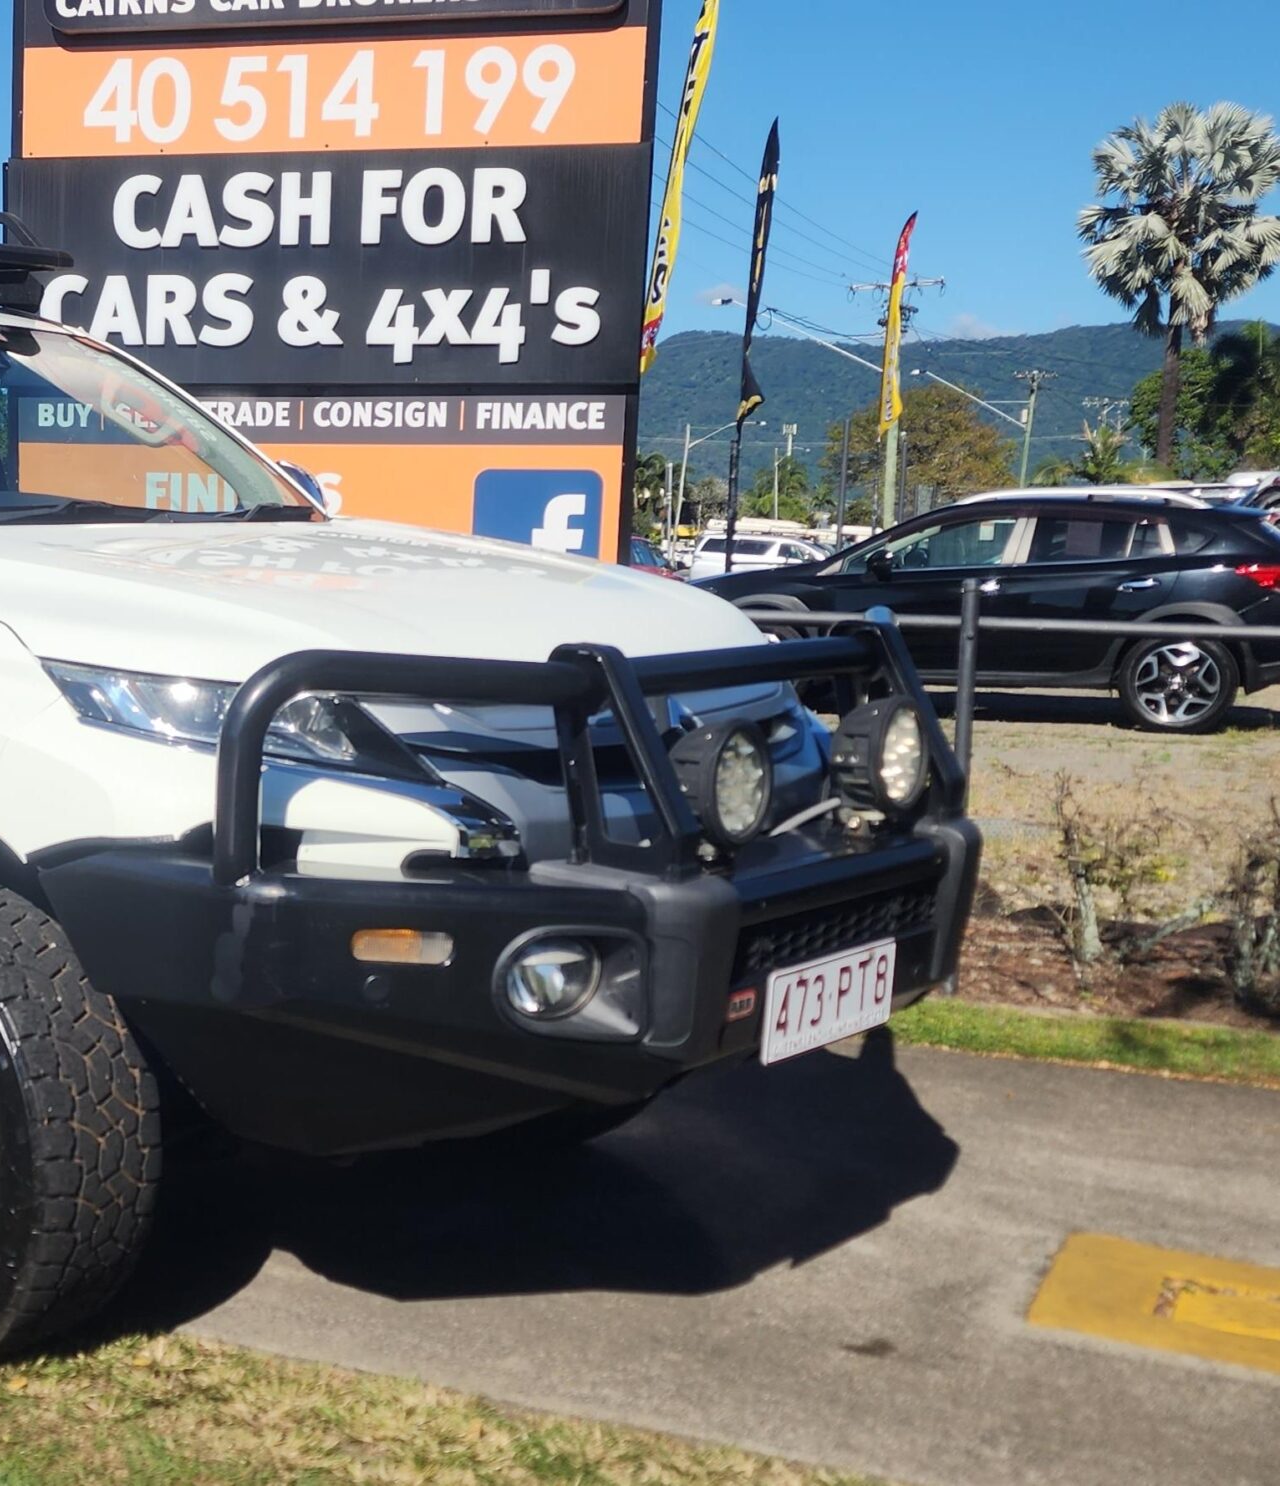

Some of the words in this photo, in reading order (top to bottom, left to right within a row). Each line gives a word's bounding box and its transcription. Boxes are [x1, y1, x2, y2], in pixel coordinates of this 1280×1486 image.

[82, 57, 192, 144] 40
[213, 50, 379, 141] 514
[413, 44, 576, 135] 199
[112, 171, 332, 249] CASH
[360, 167, 527, 246] FOR
[41, 272, 254, 347] CARS
[277, 276, 344, 347] &
[38, 403, 93, 428] BUY
[313, 401, 448, 429] CONSIGN
[475, 401, 606, 430] FINANCE
[145, 472, 239, 512] FIN
